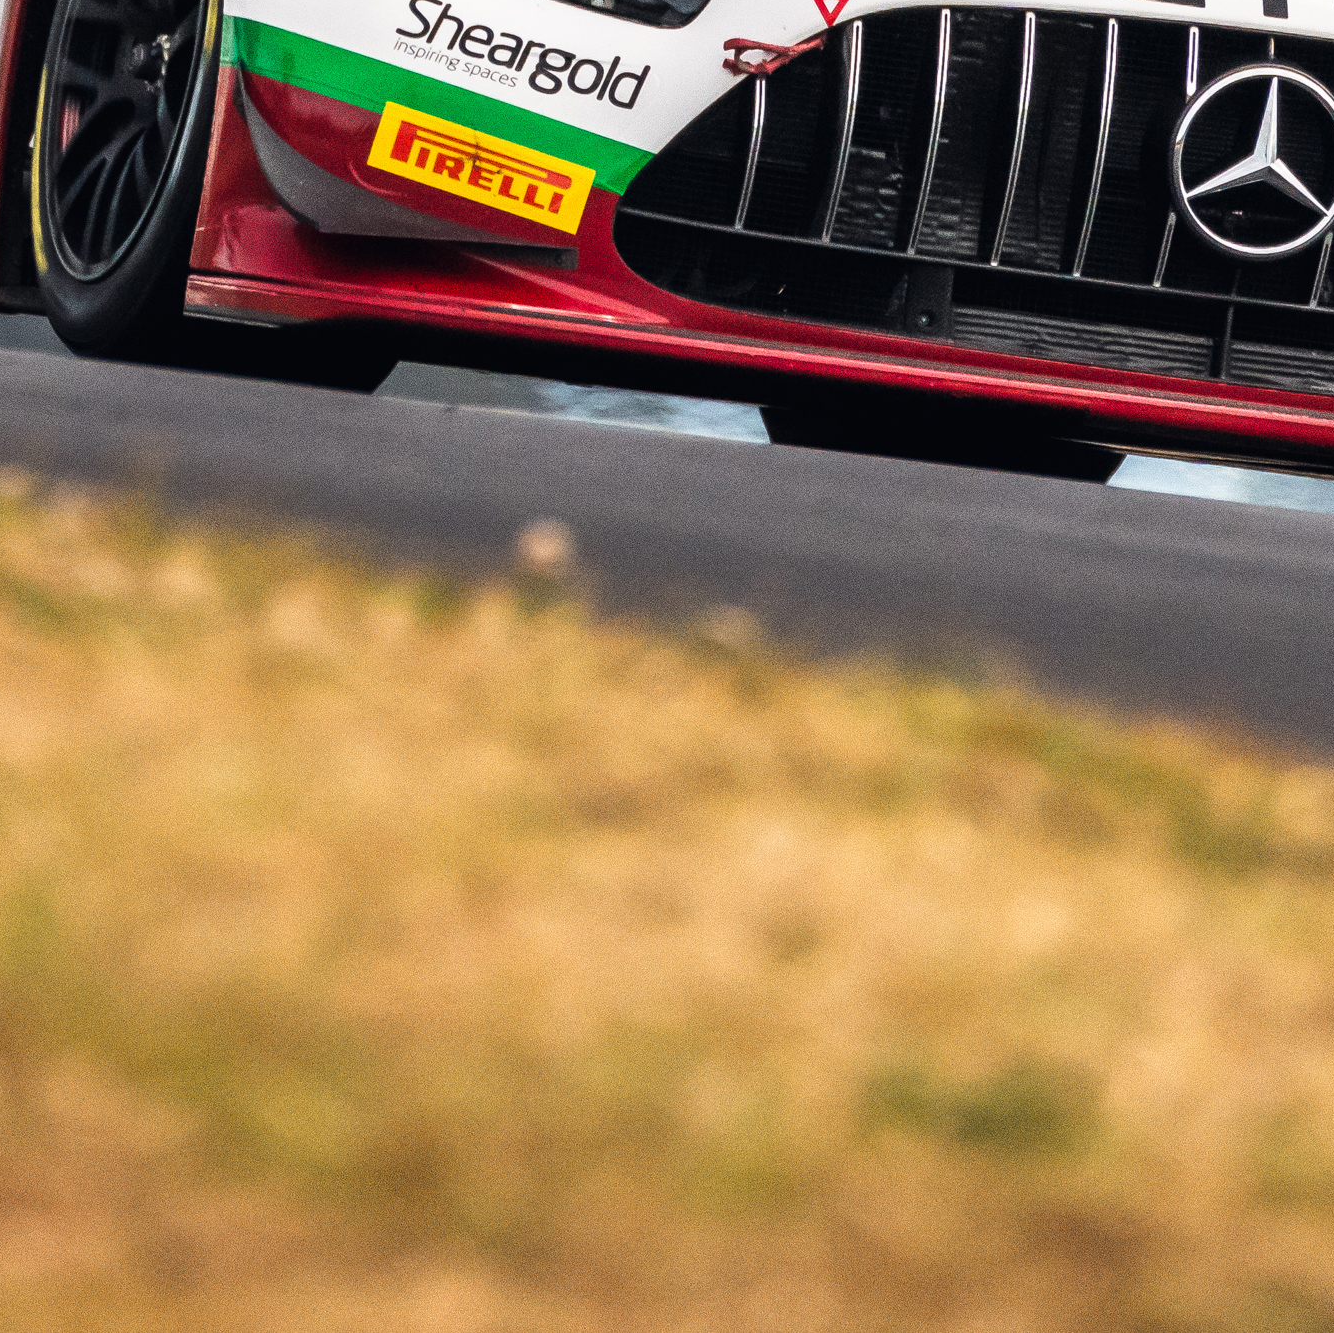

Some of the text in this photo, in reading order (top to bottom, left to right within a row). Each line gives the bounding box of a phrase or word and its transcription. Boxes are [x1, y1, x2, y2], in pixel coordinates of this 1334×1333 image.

[393, 37, 519, 88] inspiring spaces
[389, 120, 573, 215] PIRELLI
